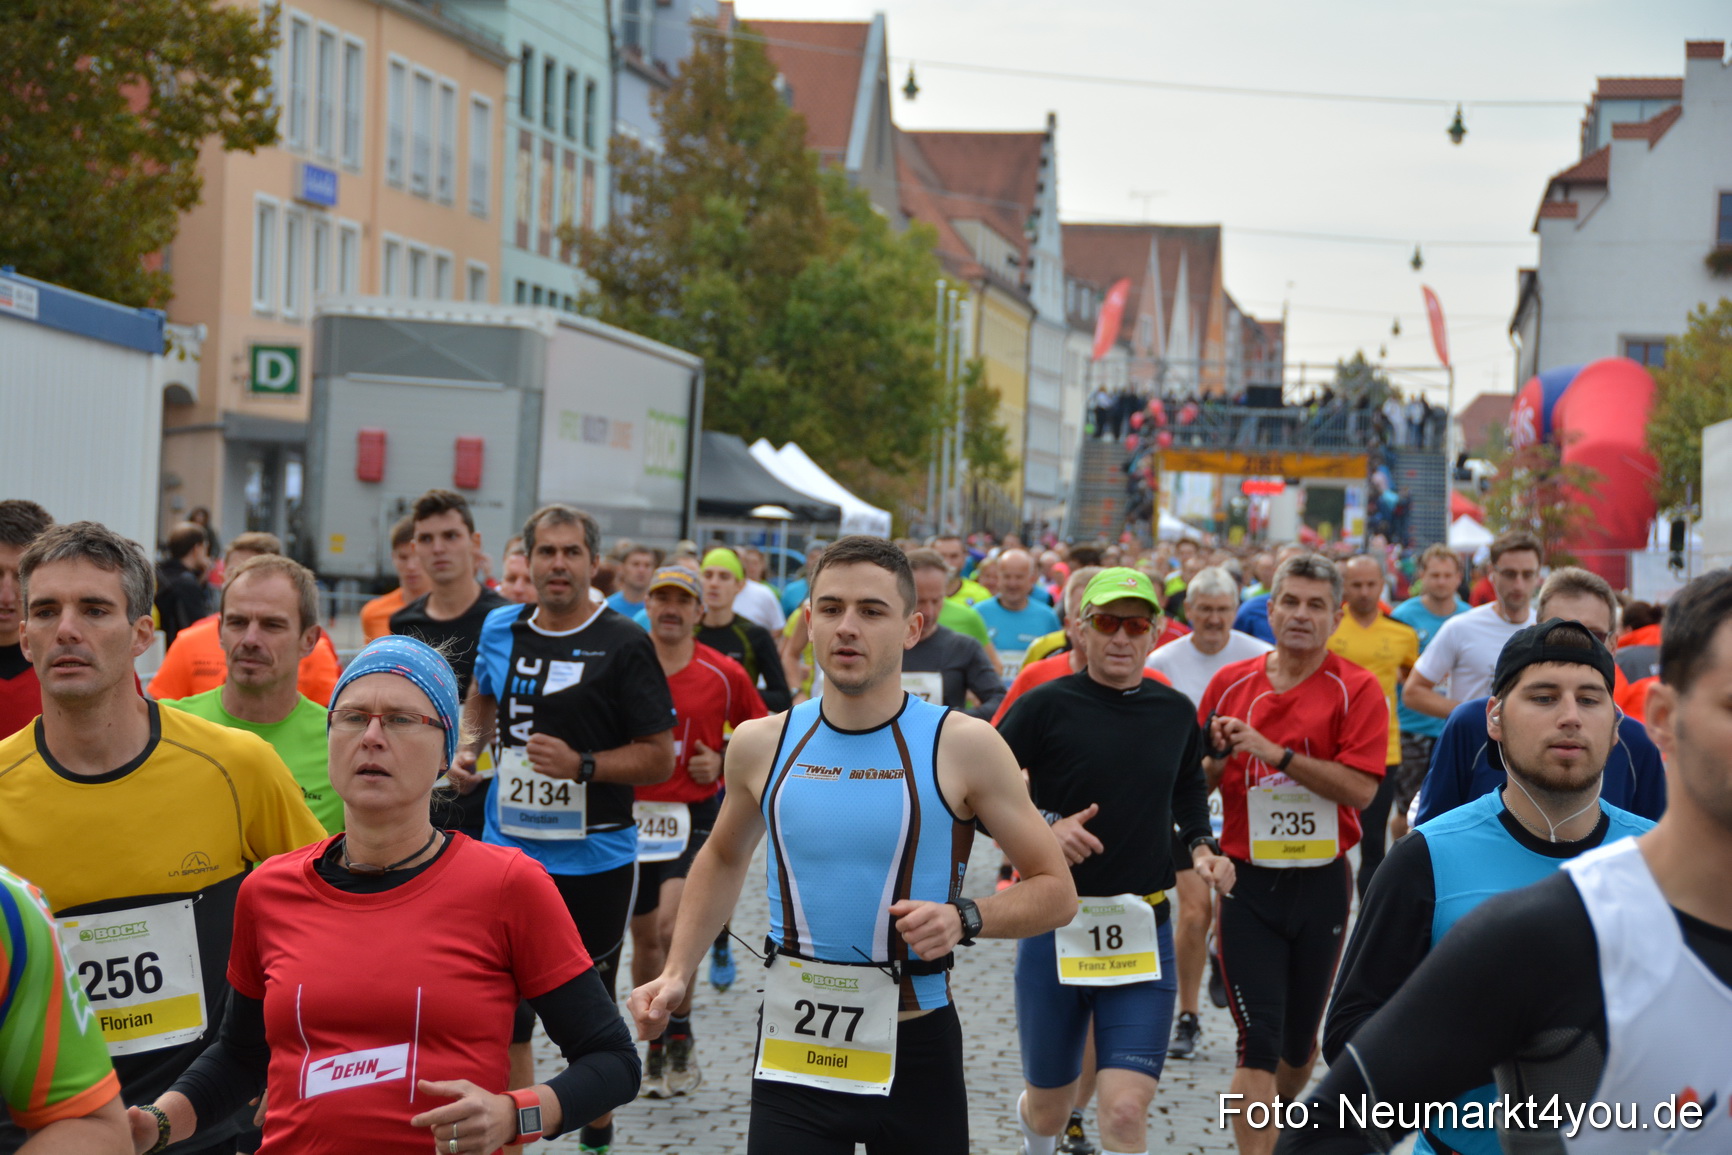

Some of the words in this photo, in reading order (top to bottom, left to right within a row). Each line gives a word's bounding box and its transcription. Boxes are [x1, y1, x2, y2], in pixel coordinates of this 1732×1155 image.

[256, 350, 295, 390] D
[508, 656, 543, 750] ATEC
[878, 769, 905, 780] RACER
[510, 777, 571, 806] 2134
[519, 812, 559, 825] Christian
[1270, 811, 1316, 836] 235
[95, 921, 149, 940] BOCK
[1088, 924, 1124, 951] 18
[1078, 960, 1106, 972] Franz
[1109, 958, 1138, 971] Xaver
[78, 951, 164, 1002] 256
[814, 974, 859, 990] BOCK
[100, 1012, 153, 1032] Florian
[769, 1025, 775, 1033] B
[794, 999, 865, 1042] 277
[331, 1058, 380, 1081] DEHN
[806, 1050, 849, 1069] Daniel
